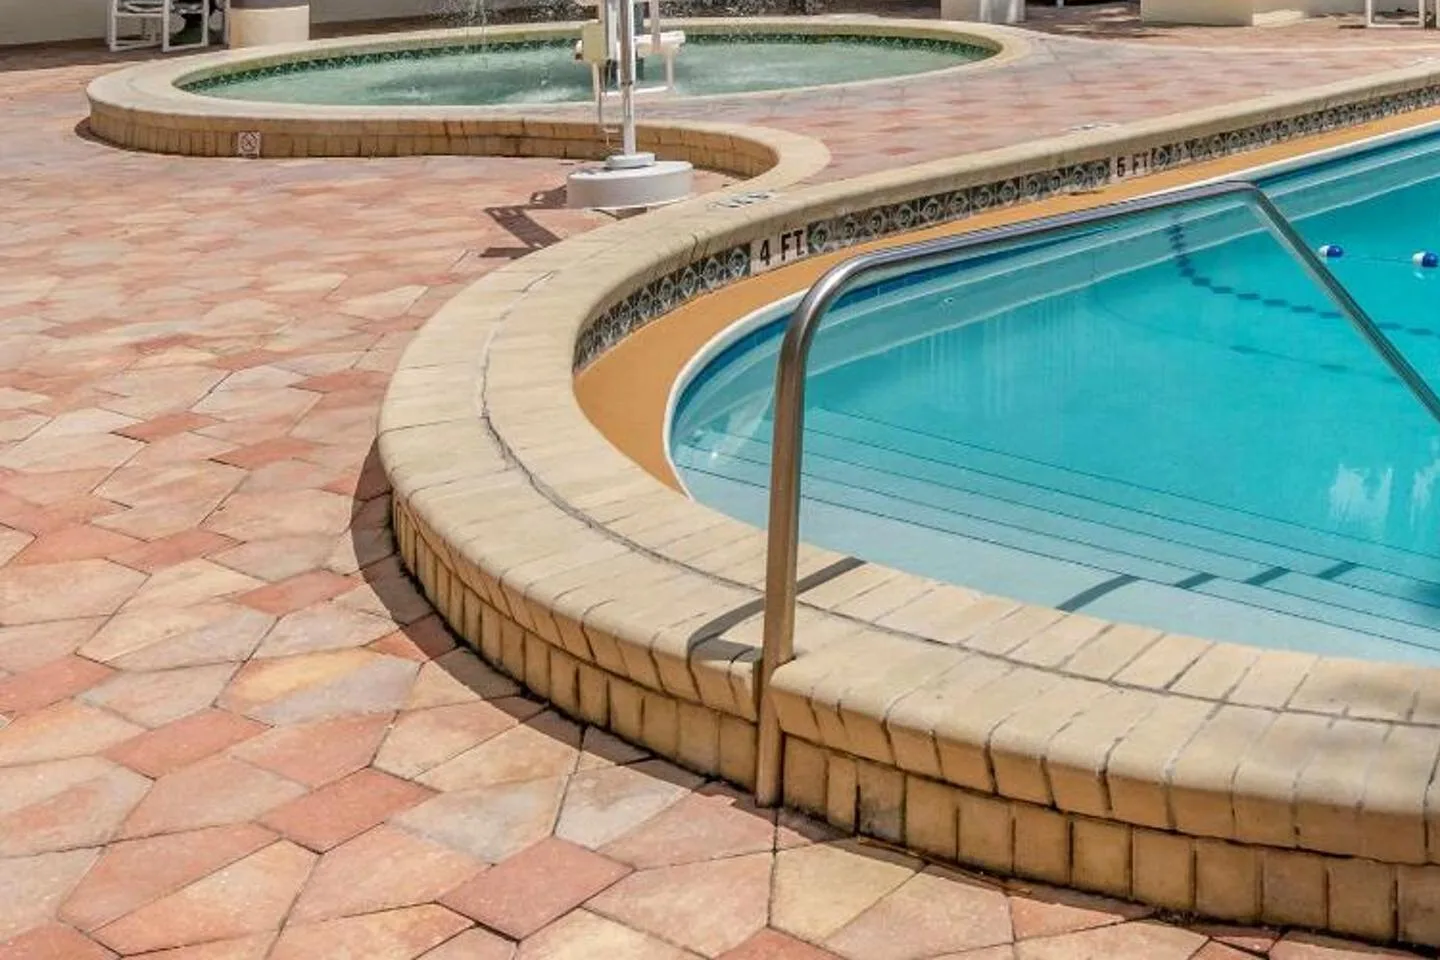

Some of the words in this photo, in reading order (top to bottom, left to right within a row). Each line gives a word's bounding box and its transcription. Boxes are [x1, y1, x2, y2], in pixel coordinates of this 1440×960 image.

[1132, 151, 1149, 175] FT
[760, 239, 770, 266] 4
[781, 230, 804, 261] FT
